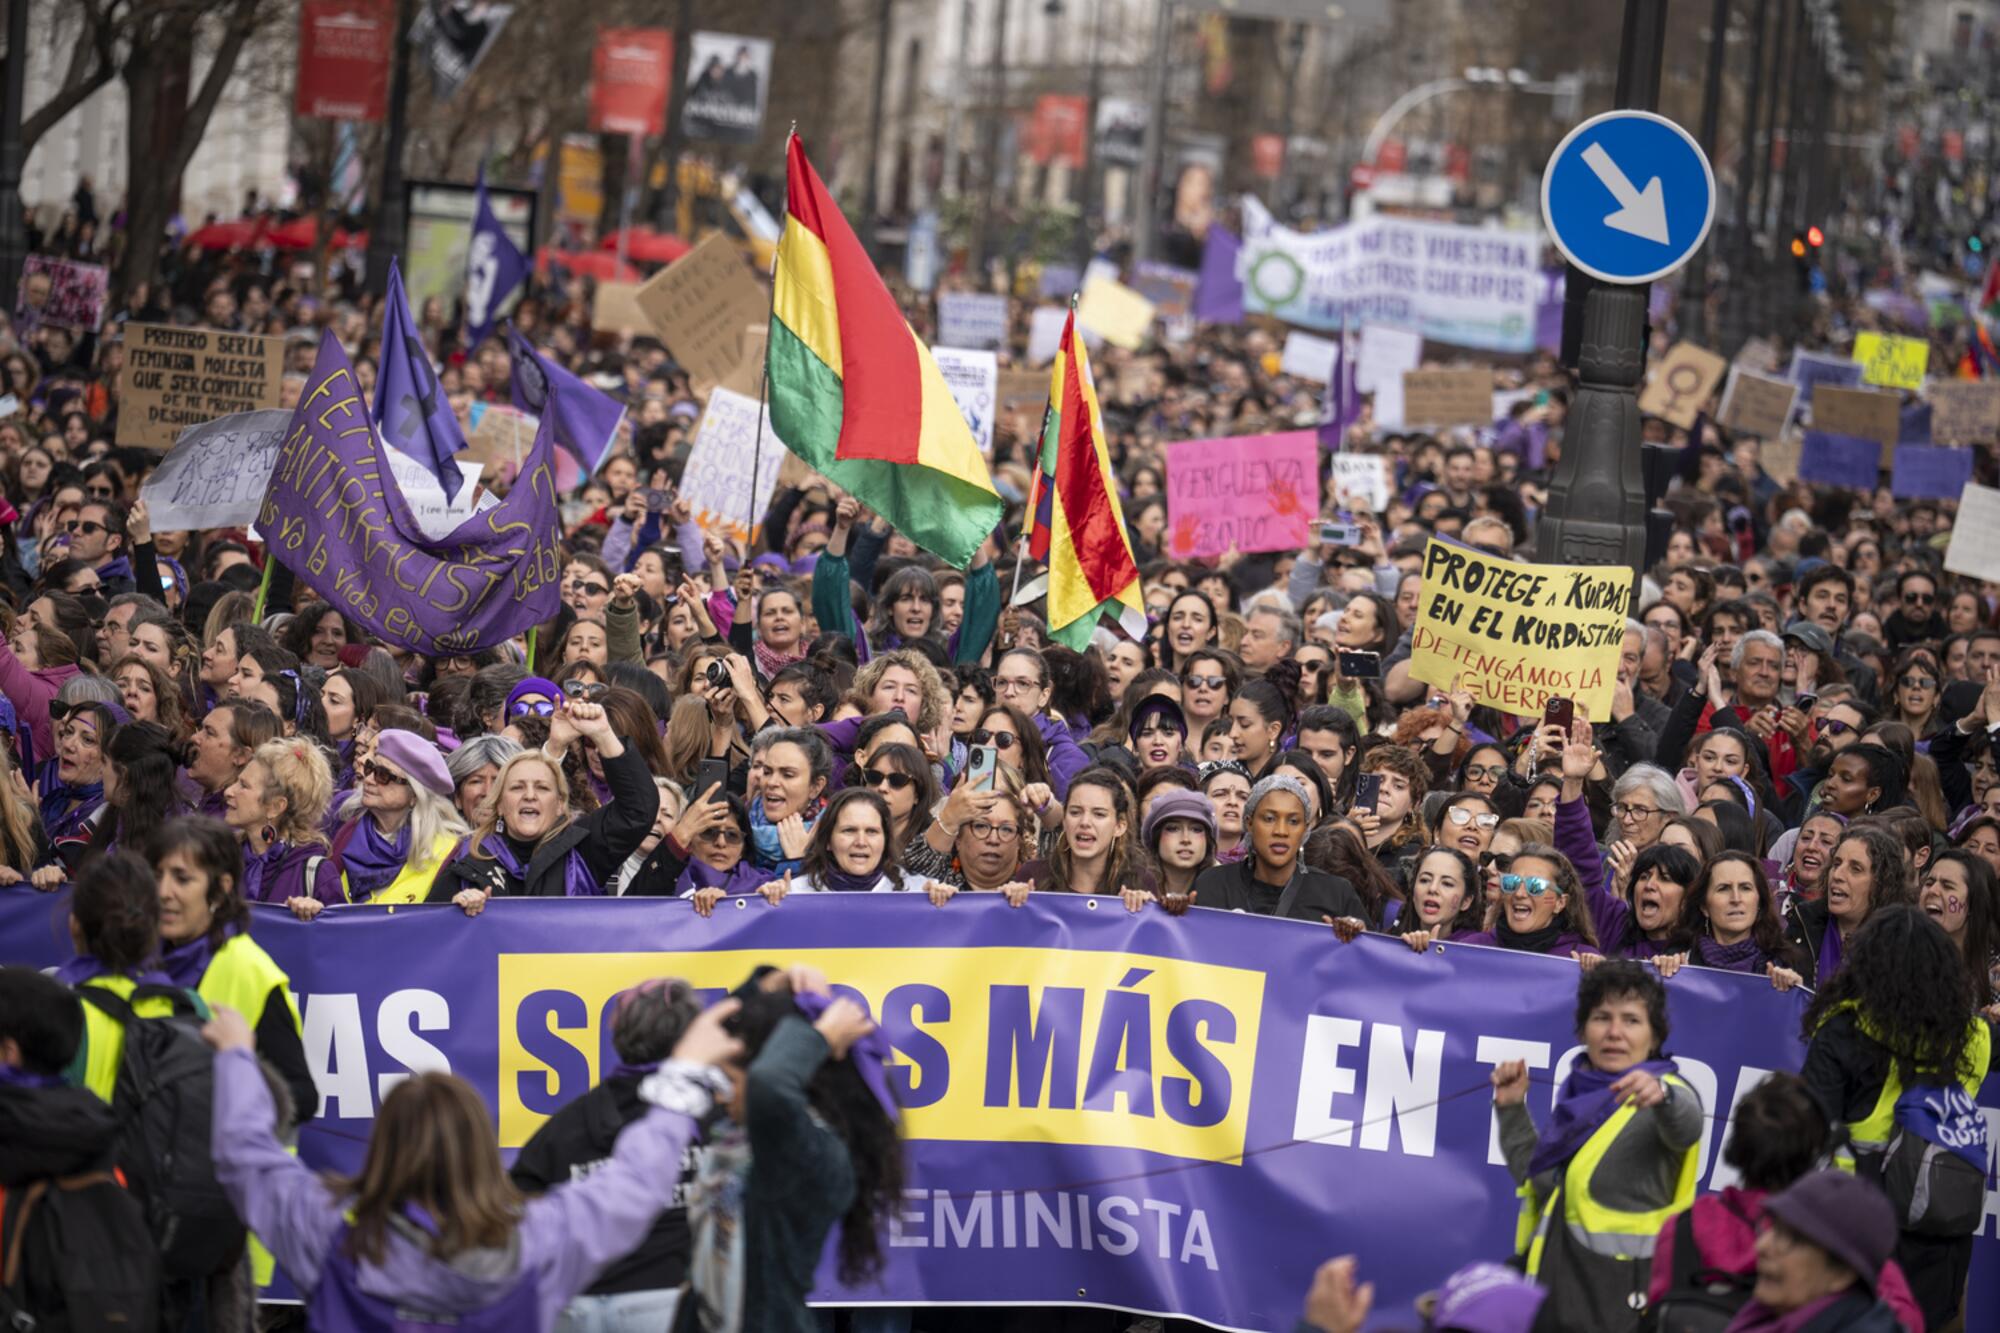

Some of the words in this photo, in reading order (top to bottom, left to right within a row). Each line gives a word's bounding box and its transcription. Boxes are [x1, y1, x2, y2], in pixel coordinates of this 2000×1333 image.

[217, 335, 247, 355] SER
[248, 337, 266, 357] LA
[133, 371, 163, 390] QUE
[170, 374, 200, 393] SER
[203, 356, 266, 379] MOLESTA
[163, 393, 180, 406] DE
[185, 395, 201, 408] MI
[305, 533, 329, 577] la
[384, 606, 425, 645] en
[1425, 543, 1549, 607] PROTEGE
[1545, 592, 1557, 607] A
[1564, 572, 1632, 615] KURDAS
[1428, 593, 1465, 625] EN
[1468, 606, 1504, 640] EL
[1461, 671, 1576, 710] GUERR
[1579, 667, 1602, 689] LA
[290, 988, 452, 1120] AS
[983, 967, 1238, 1128] MÁS
[1292, 1013, 1446, 1158] EN
[886, 1188, 1220, 1272] EMINISTA
